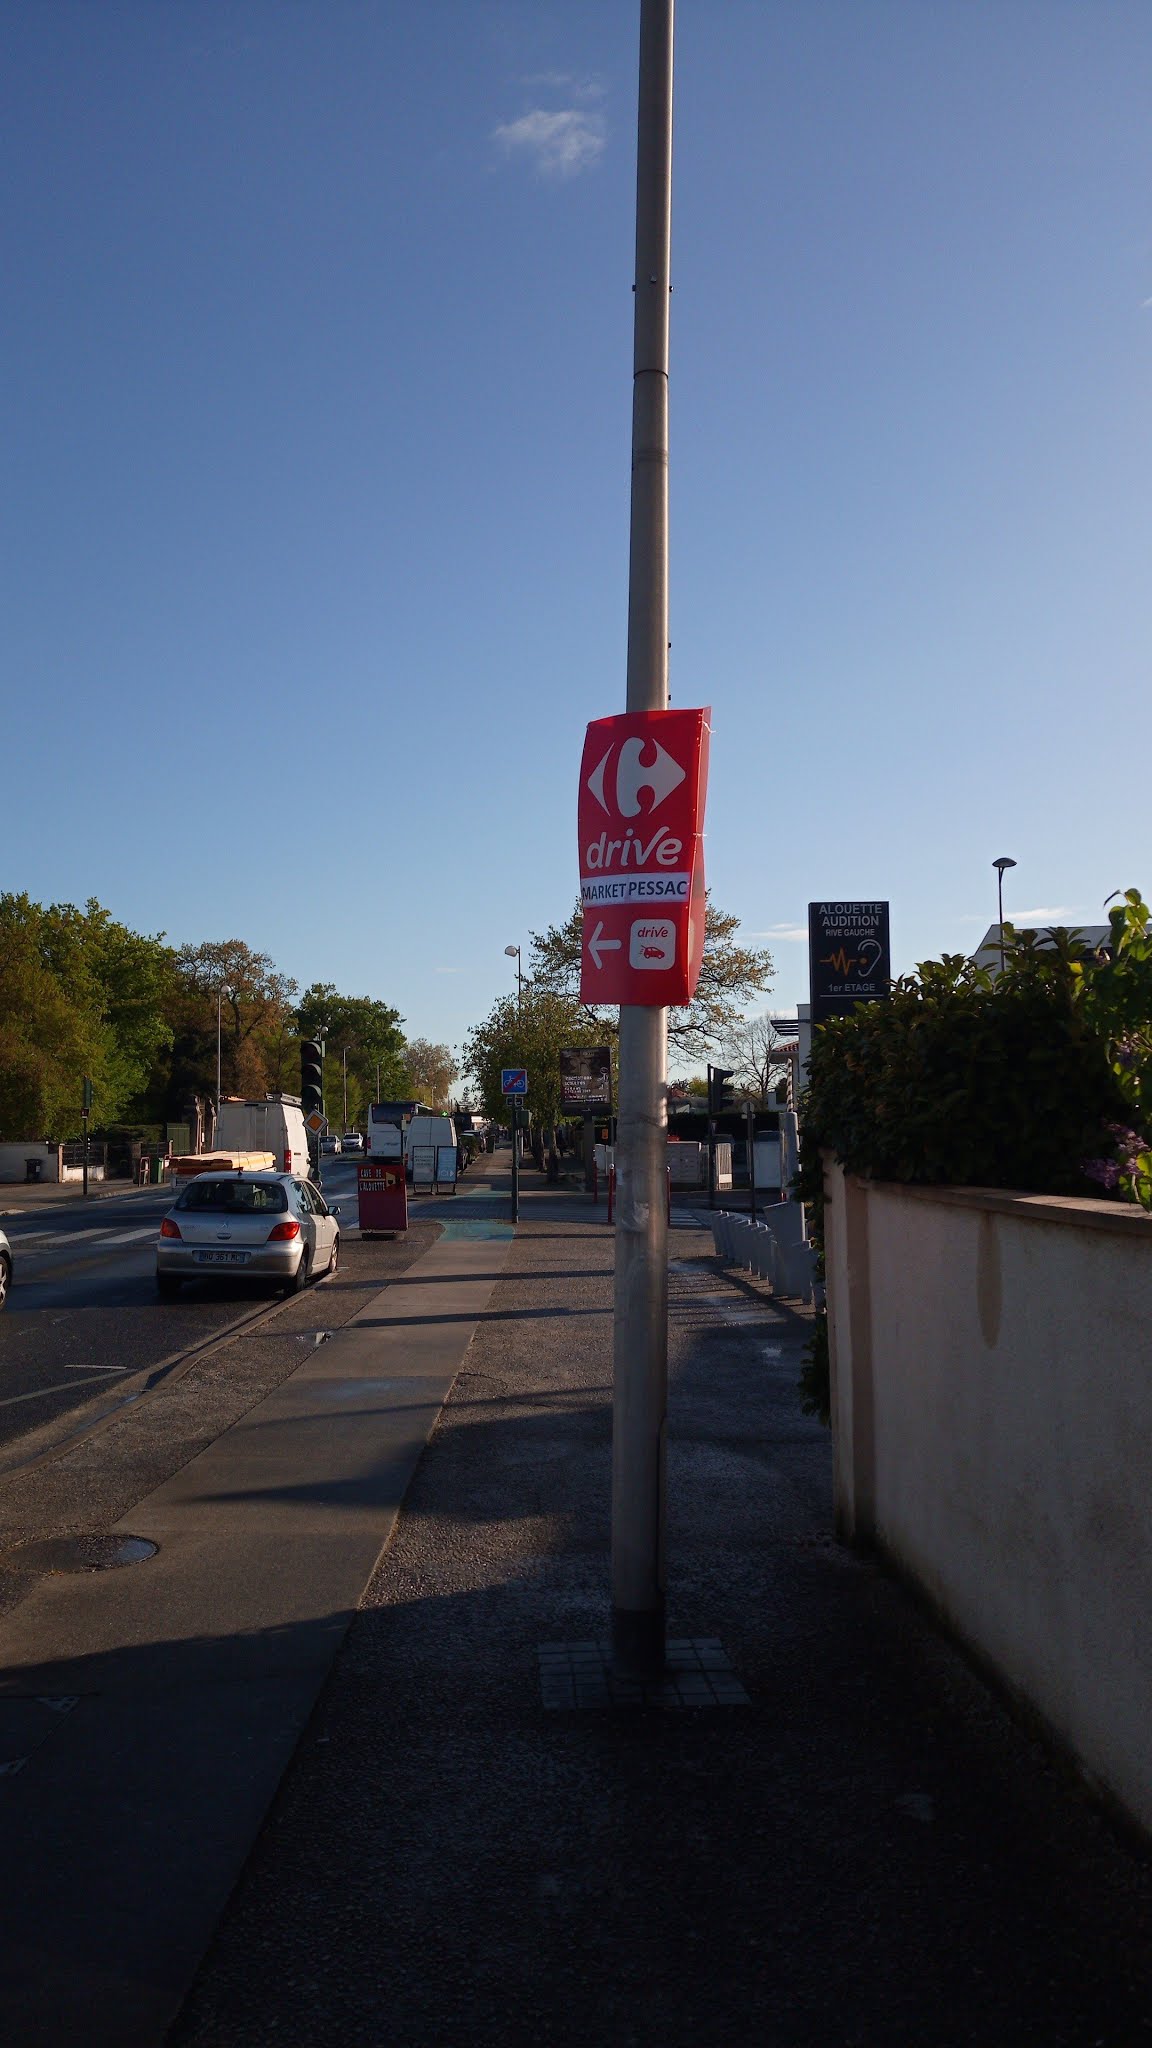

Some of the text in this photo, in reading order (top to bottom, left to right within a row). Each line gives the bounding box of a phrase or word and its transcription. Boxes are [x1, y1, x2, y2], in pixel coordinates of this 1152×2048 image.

[586, 825, 682, 869] drive
[581, 880, 687, 901] MARKET PESSAC
[819, 904, 882, 914] ALOUETTE
[822, 915, 879, 926] AUDITION
[637, 926, 669, 939] drive
[825, 928, 875, 936] RIVE GAUCHE
[828, 983, 875, 992] 1er ETAGE
[360, 1168, 382, 1178] CAVE DE
